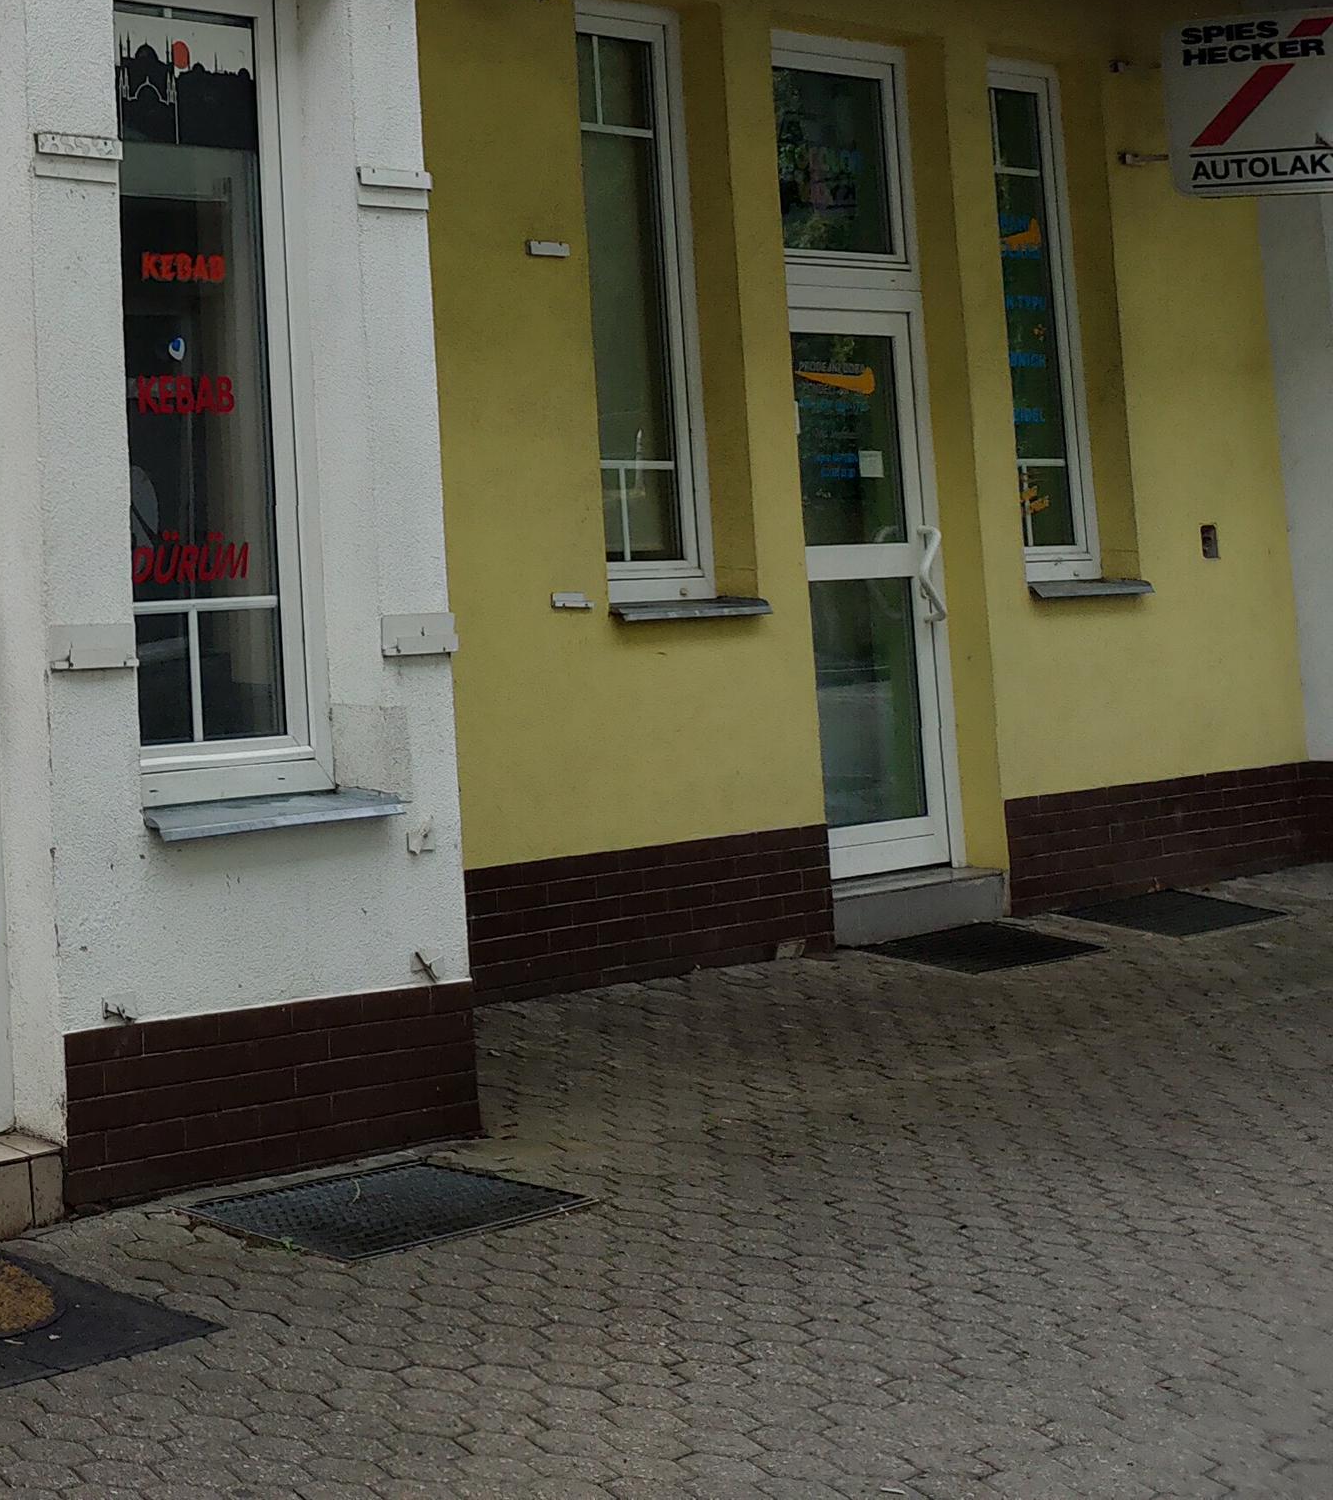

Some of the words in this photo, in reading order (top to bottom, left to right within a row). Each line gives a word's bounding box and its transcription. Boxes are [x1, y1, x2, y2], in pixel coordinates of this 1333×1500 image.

[1181, 20, 1280, 45] SPIES
[1182, 38, 1326, 67] HECKER
[1191, 153, 1333, 181] AUTOLAK
[141, 251, 226, 282] KEBAB
[137, 374, 236, 416] KEBAB
[131, 531, 250, 584] DÜRÜM
